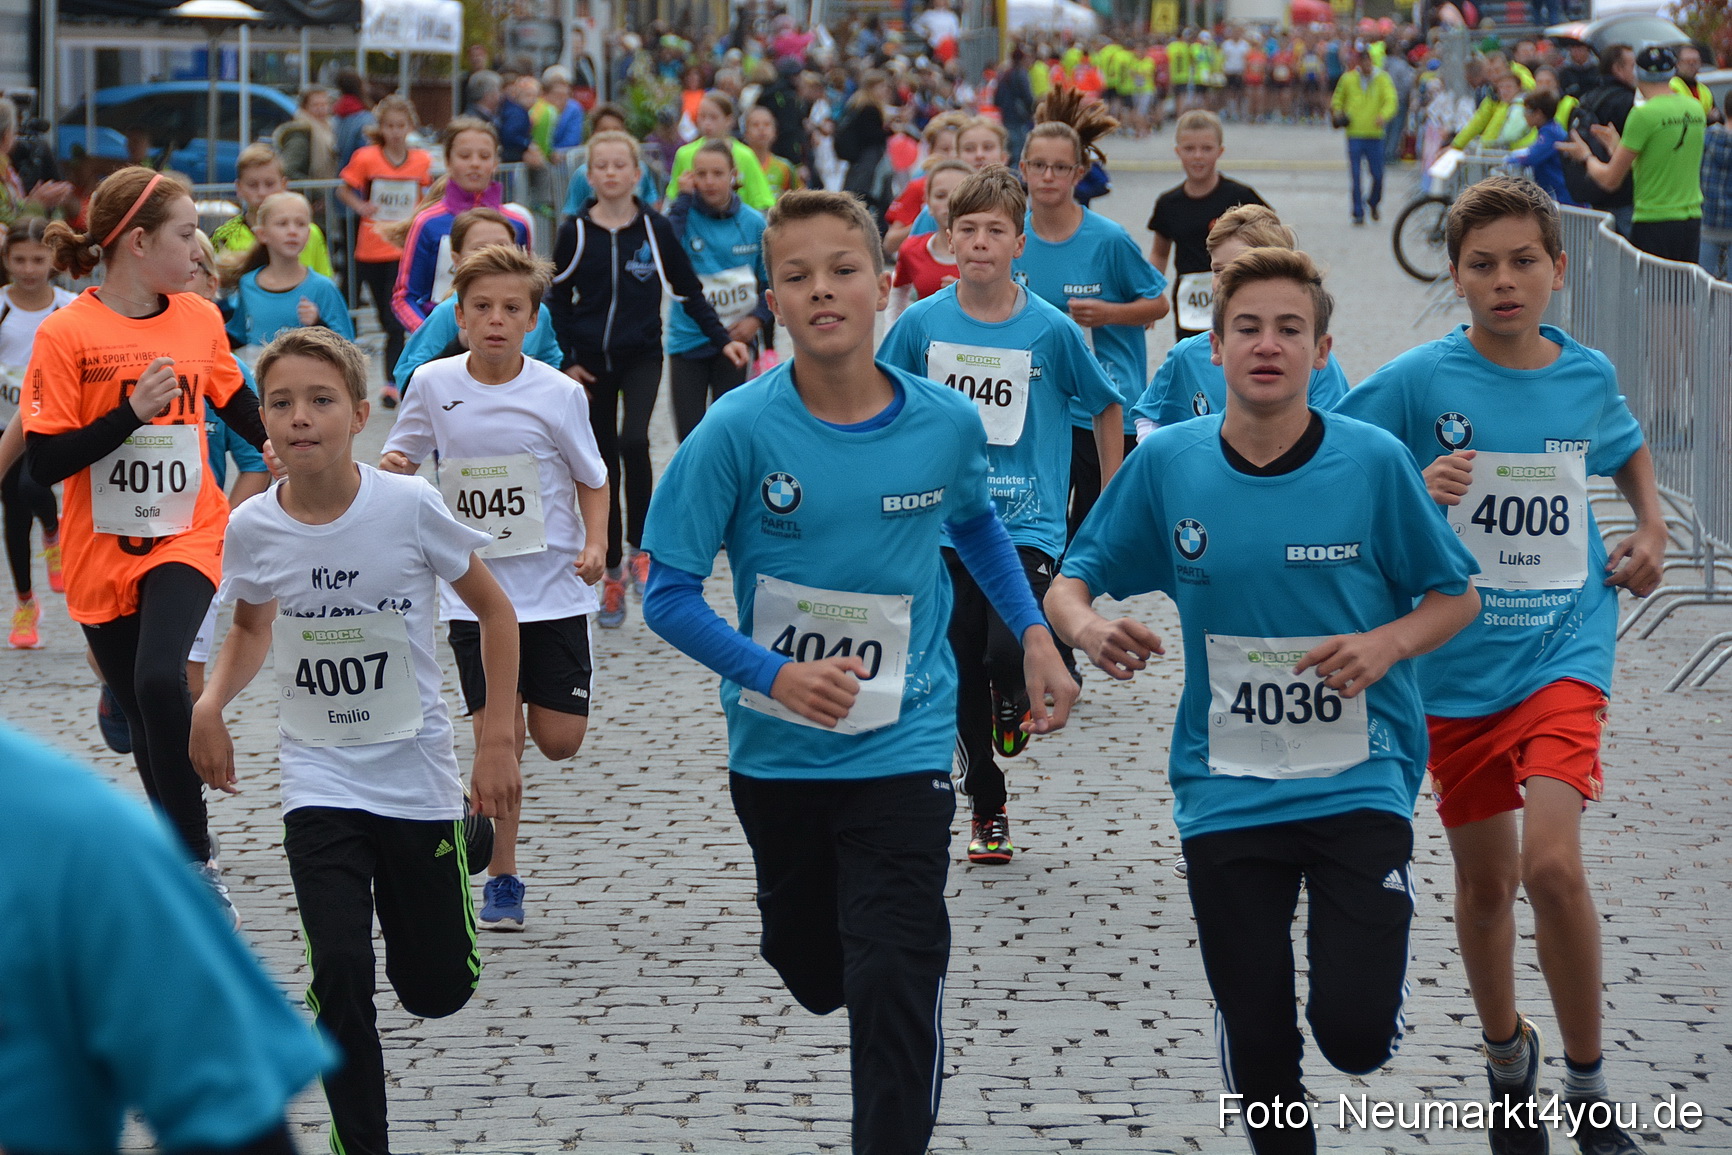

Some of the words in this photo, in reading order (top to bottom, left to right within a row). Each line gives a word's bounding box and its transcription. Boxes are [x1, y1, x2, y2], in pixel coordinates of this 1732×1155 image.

[1063, 284, 1102, 295] BOCK
[102, 352, 130, 364] SPORT
[133, 351, 158, 361] VIBES
[965, 354, 1001, 366] BOCK
[135, 436, 173, 446] BOCK
[1546, 439, 1591, 453] BOCK
[108, 459, 187, 493] 4010
[471, 465, 508, 477] BOCK
[1511, 467, 1556, 477] BOCK
[987, 475, 1025, 485] markter
[883, 488, 945, 512] BOCK
[989, 487, 1016, 499] tlauf
[456, 486, 525, 519] 4045
[134, 505, 160, 518] Sofia
[1471, 494, 1570, 536] 4008
[762, 516, 802, 532] PARTL
[1286, 544, 1360, 562] BOCK
[1499, 550, 1541, 566] Lukas
[311, 566, 359, 590] Hier
[1484, 592, 1573, 608] Neumarkter
[813, 603, 868, 620] BOCK
[1483, 610, 1557, 627] Stadtlauf
[315, 628, 364, 641] BOCK
[1263, 650, 1309, 663] BOC
[295, 651, 389, 697] 4007
[1230, 682, 1342, 725] 4036
[328, 708, 371, 724] Emilio
